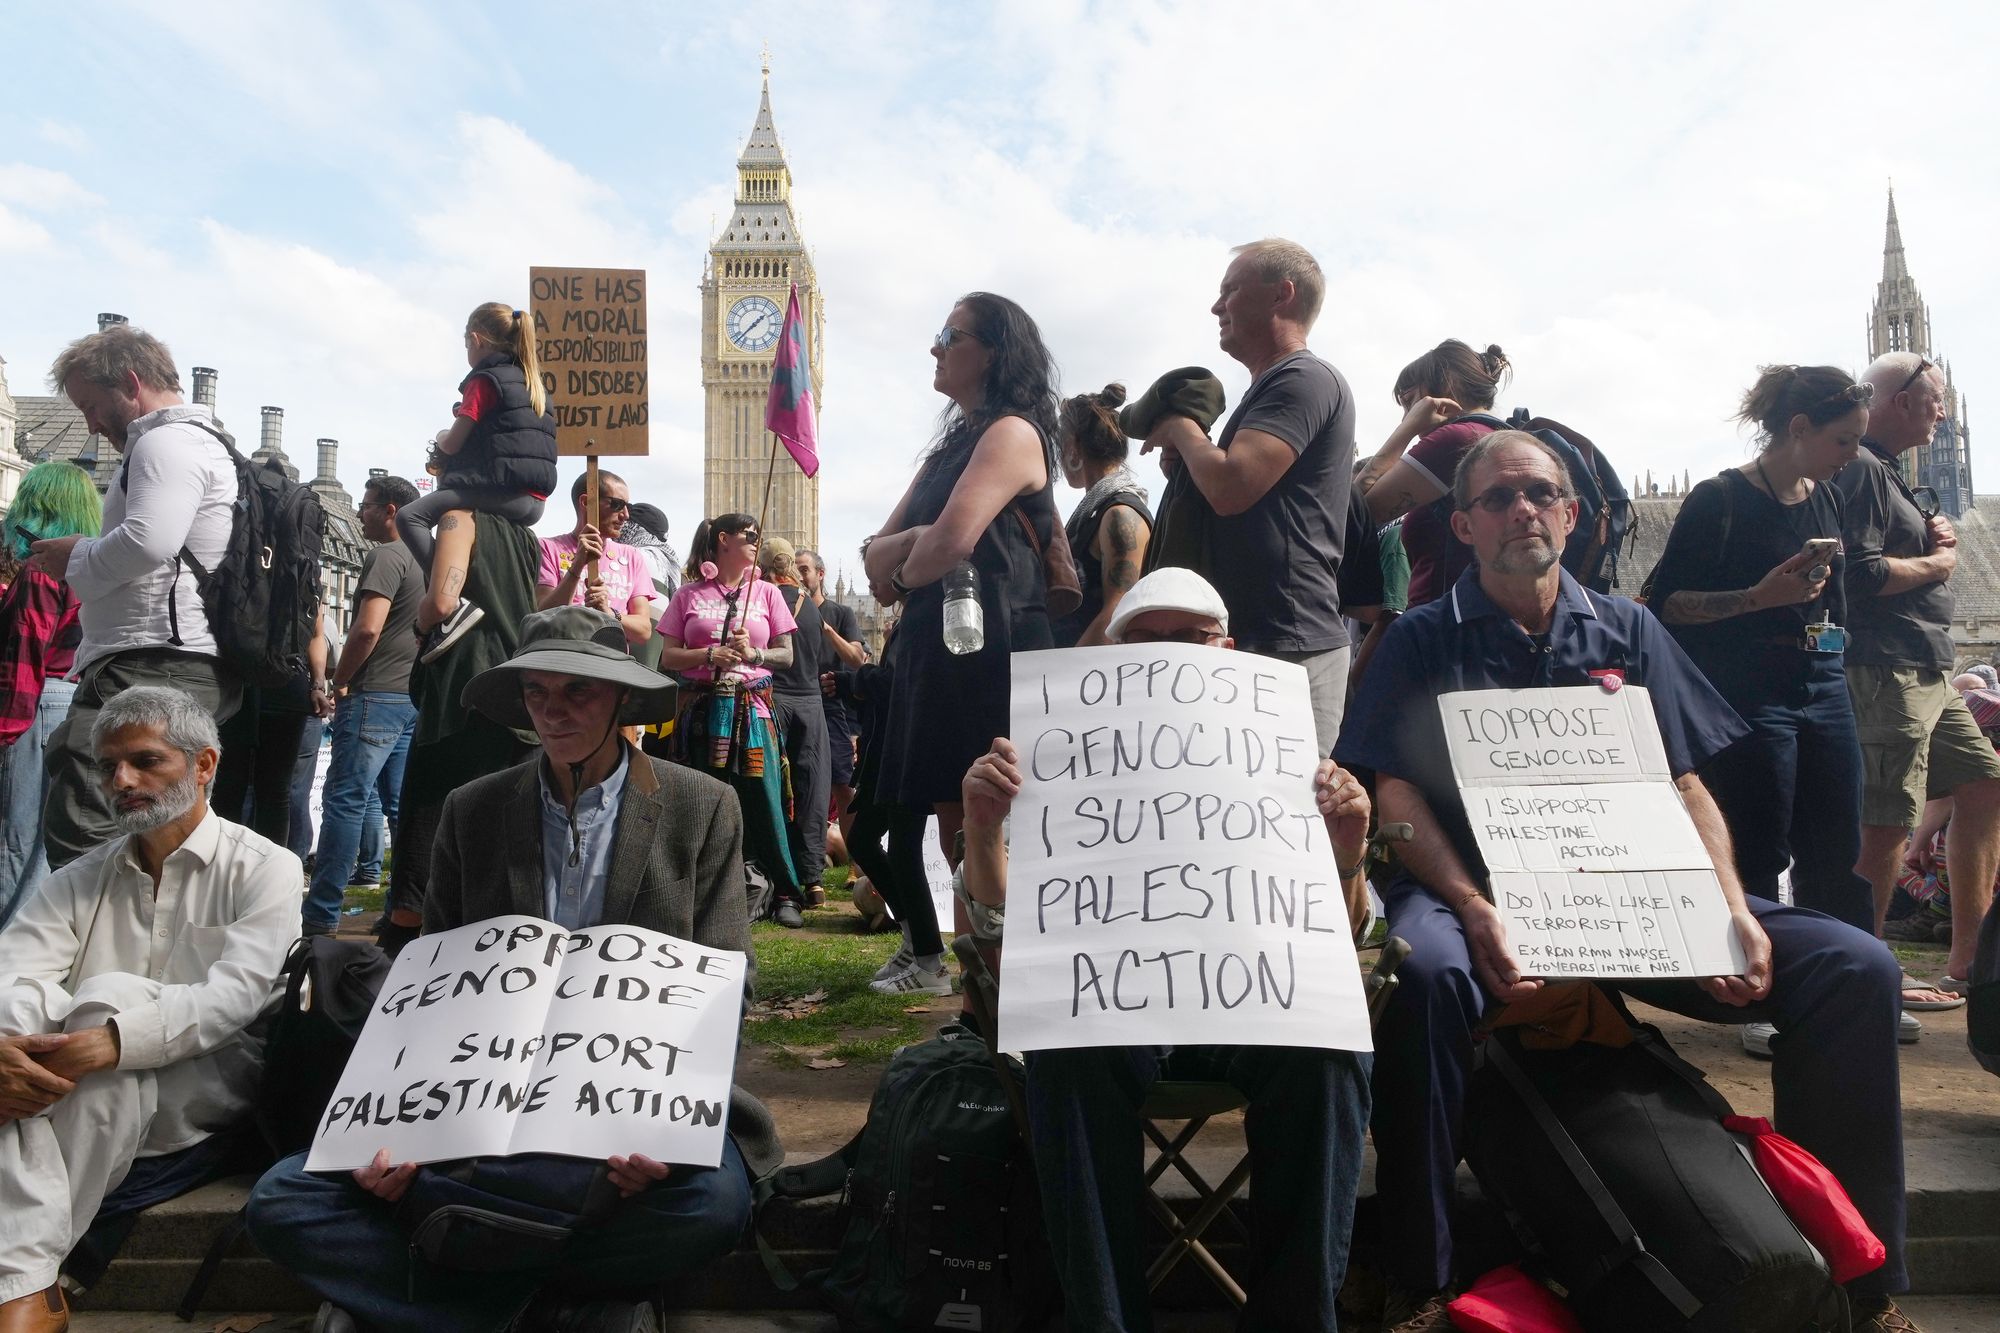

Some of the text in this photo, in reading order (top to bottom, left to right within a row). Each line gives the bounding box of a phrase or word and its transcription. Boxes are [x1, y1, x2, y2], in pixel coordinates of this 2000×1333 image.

[532, 276, 642, 303] ONE HAS
[534, 307, 646, 335] A MORAL
[541, 370, 647, 396] O DISOBEY
[553, 401, 648, 429] JUST LAWS
[1042, 659, 1280, 717] I OPPOSE
[1031, 720, 1305, 781] GENOCIDE
[1489, 748, 1625, 771] GENOCIDE
[1485, 797, 1611, 817] I SUPPORT
[1042, 791, 1322, 858] I SUPPORT
[1485, 824, 1596, 842] PALESTINE
[1560, 844, 1629, 860] ACTION
[1038, 863, 1335, 934] PALESTINE
[1544, 891, 1552, 910] I
[1562, 894, 1611, 908] LOOK
[1620, 895, 1670, 910] LIKE
[1681, 895, 1695, 909] A
[1514, 916, 1629, 933] TERRORIST
[429, 923, 731, 981] I OPPOSE
[1618, 947, 1670, 960] NURSE
[1072, 941, 1296, 1017] ACTION
[1650, 960, 1680, 974] NHS
[380, 963, 706, 1018] GENOCIDE
[393, 1031, 694, 1077] I SUPPORT
[321, 1074, 724, 1138] PALESTINE ACTION
